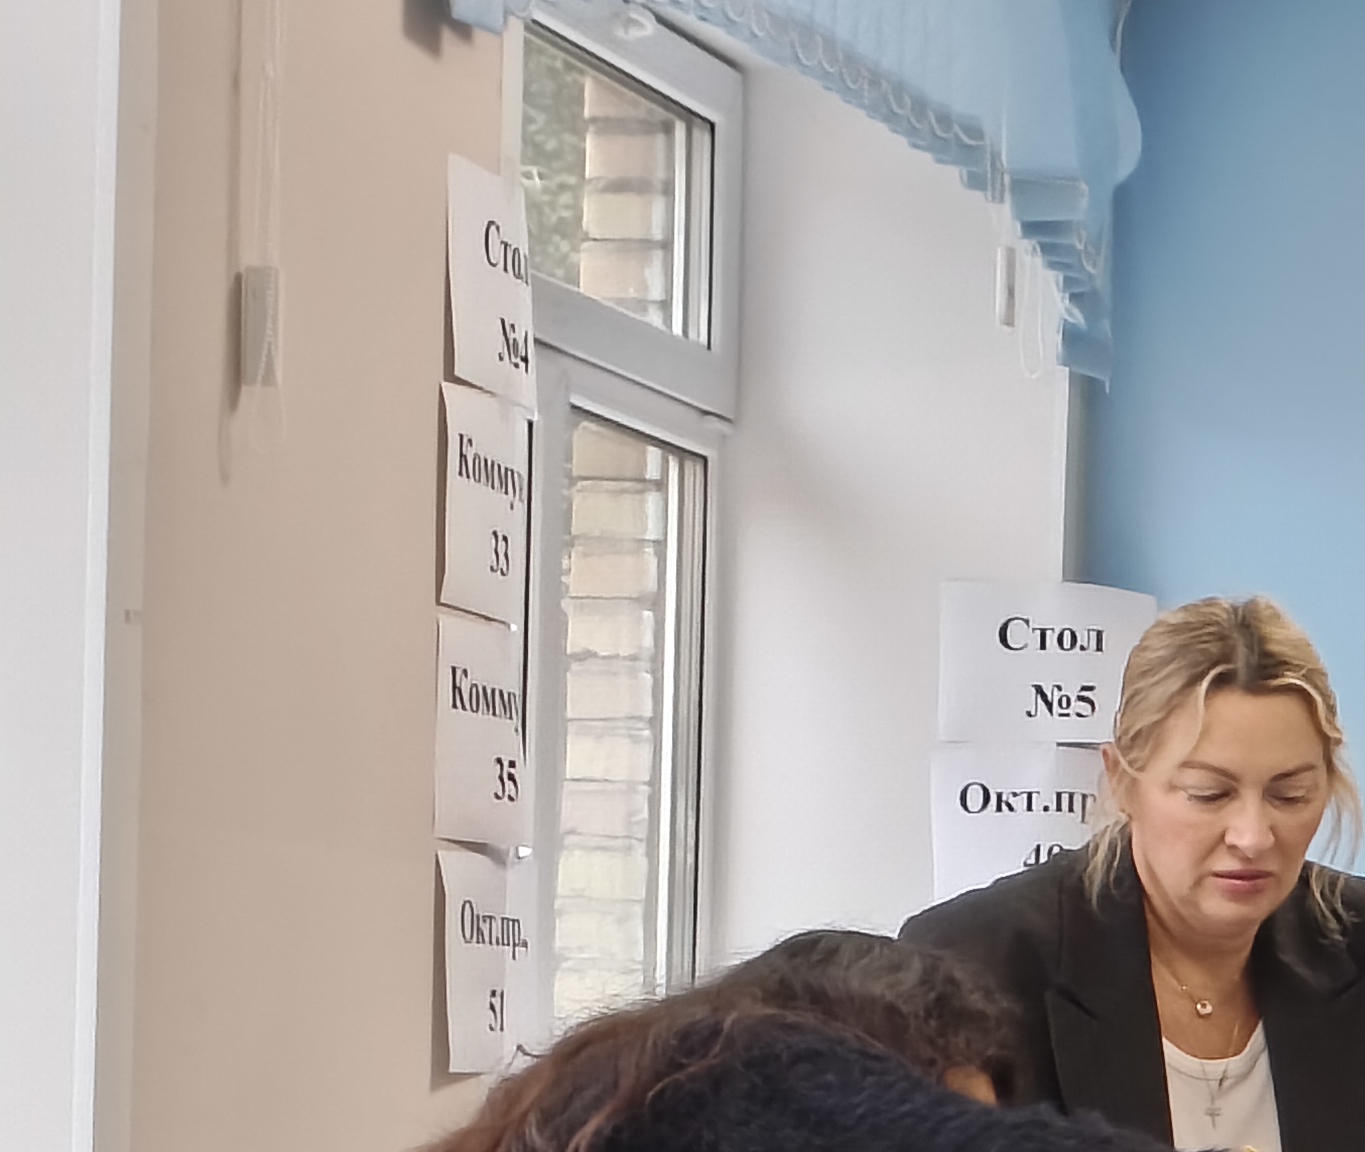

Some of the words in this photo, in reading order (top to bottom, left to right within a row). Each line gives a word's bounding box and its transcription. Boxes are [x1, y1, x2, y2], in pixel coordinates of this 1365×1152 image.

[498, 317, 530, 375] №4
[490, 529, 509, 577] 33
[999, 616, 1106, 653] Стол
[1026, 684, 1097, 719] №5
[494, 756, 519, 802] 35
[489, 989, 504, 1032] 51
